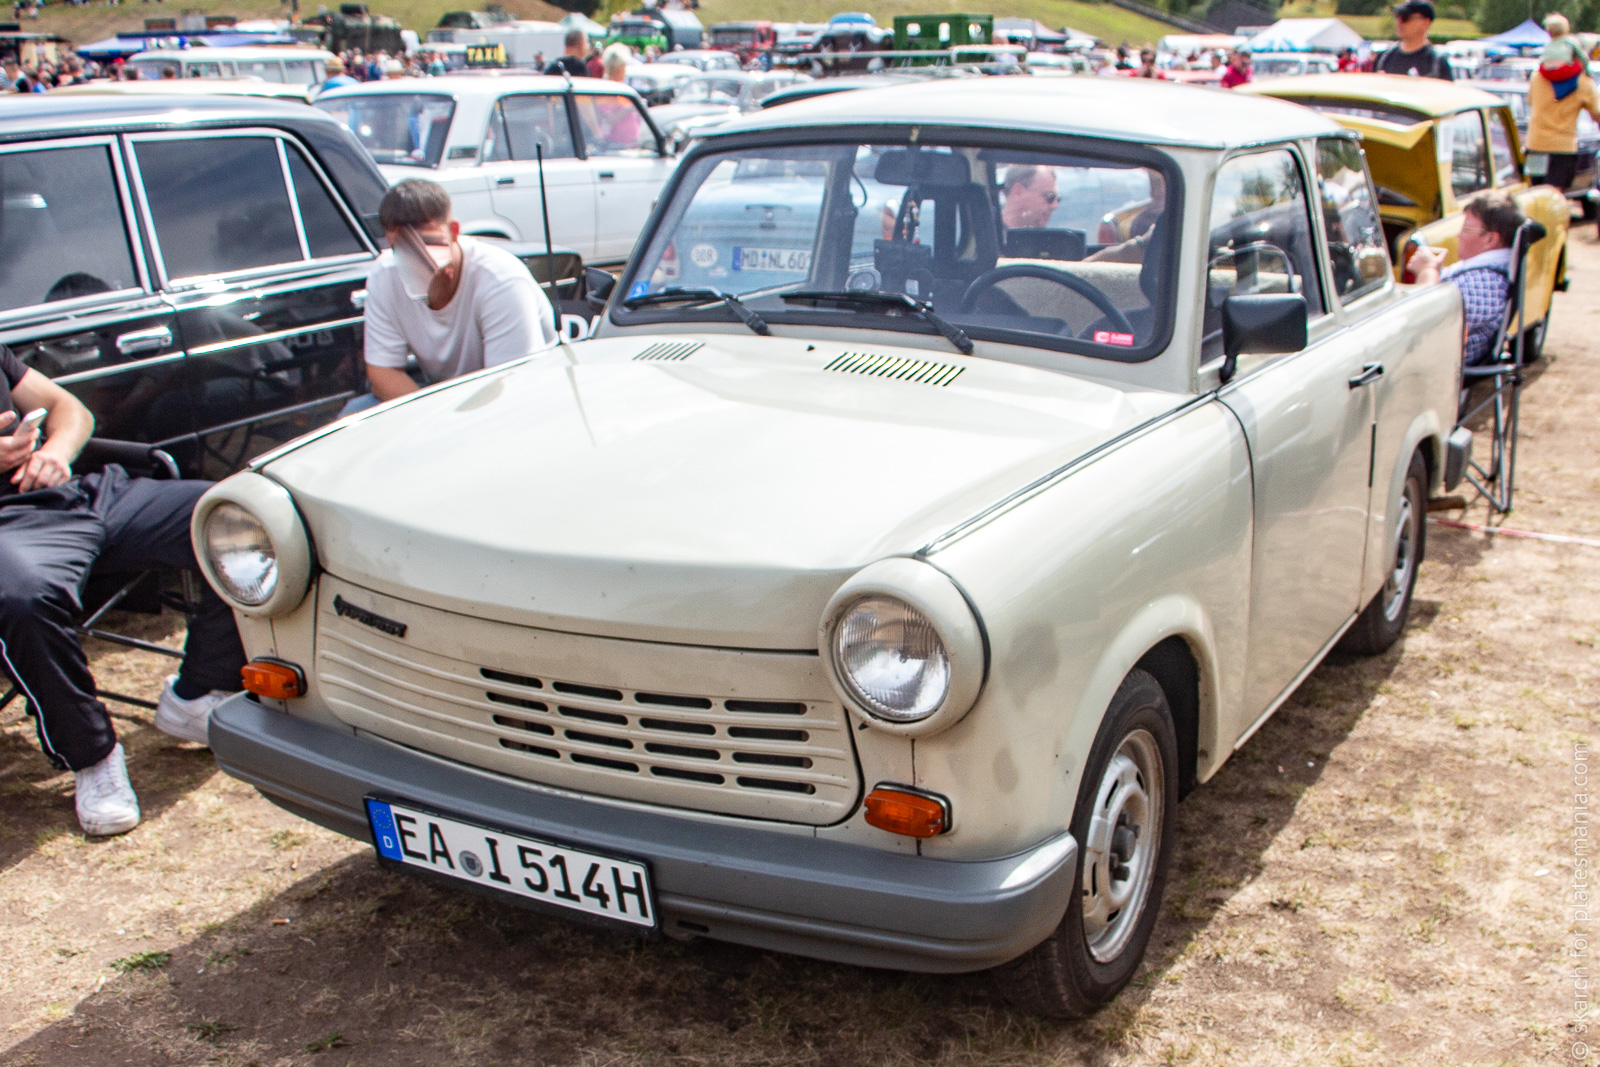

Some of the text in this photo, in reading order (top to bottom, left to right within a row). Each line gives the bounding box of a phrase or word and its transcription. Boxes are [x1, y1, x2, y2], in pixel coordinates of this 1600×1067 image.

[467, 47, 498, 61] TAXI
[768, 251, 785, 269] NL
[787, 251, 811, 270] 60
[383, 835, 394, 849] D
[393, 812, 649, 919] EA I 514H
